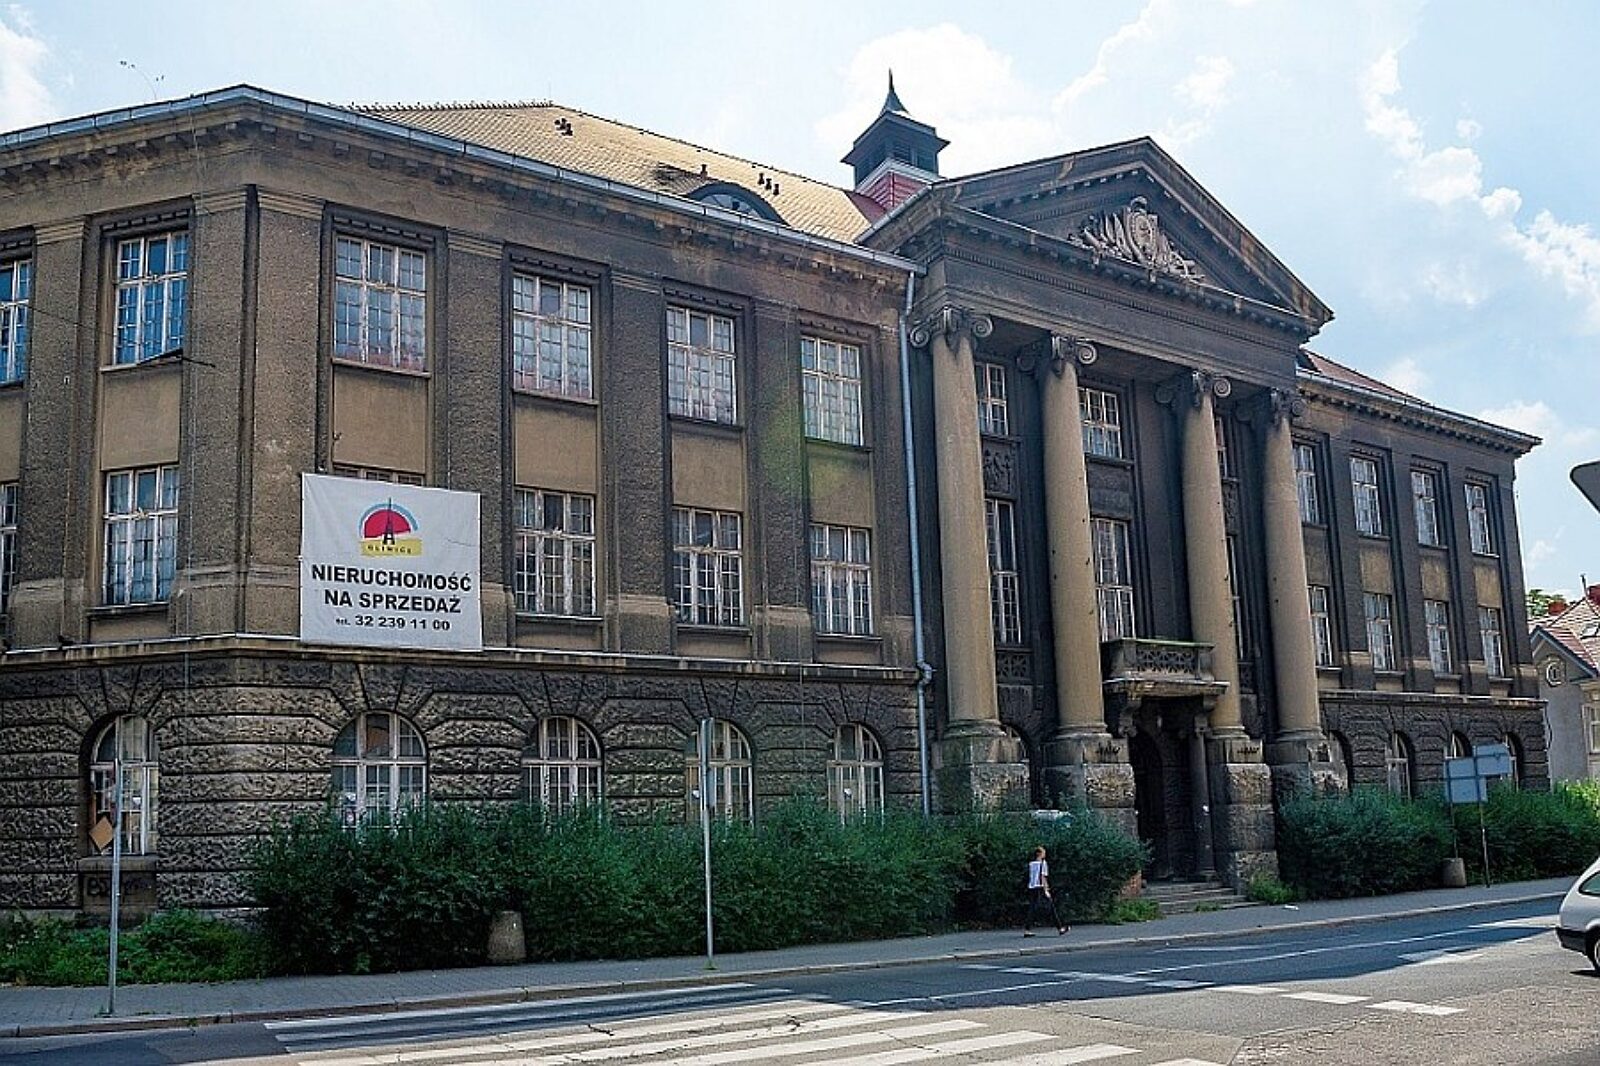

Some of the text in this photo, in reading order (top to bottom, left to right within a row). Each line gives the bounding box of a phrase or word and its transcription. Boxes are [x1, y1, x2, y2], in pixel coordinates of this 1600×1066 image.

[311, 564, 472, 591] NIERUCHOMOŚĆ
[324, 589, 461, 613] NA SPRZEDAŻ
[355, 614, 374, 627] 32
[378, 615, 406, 629] 239
[410, 618, 427, 629] 11
[433, 619, 450, 631] 00
